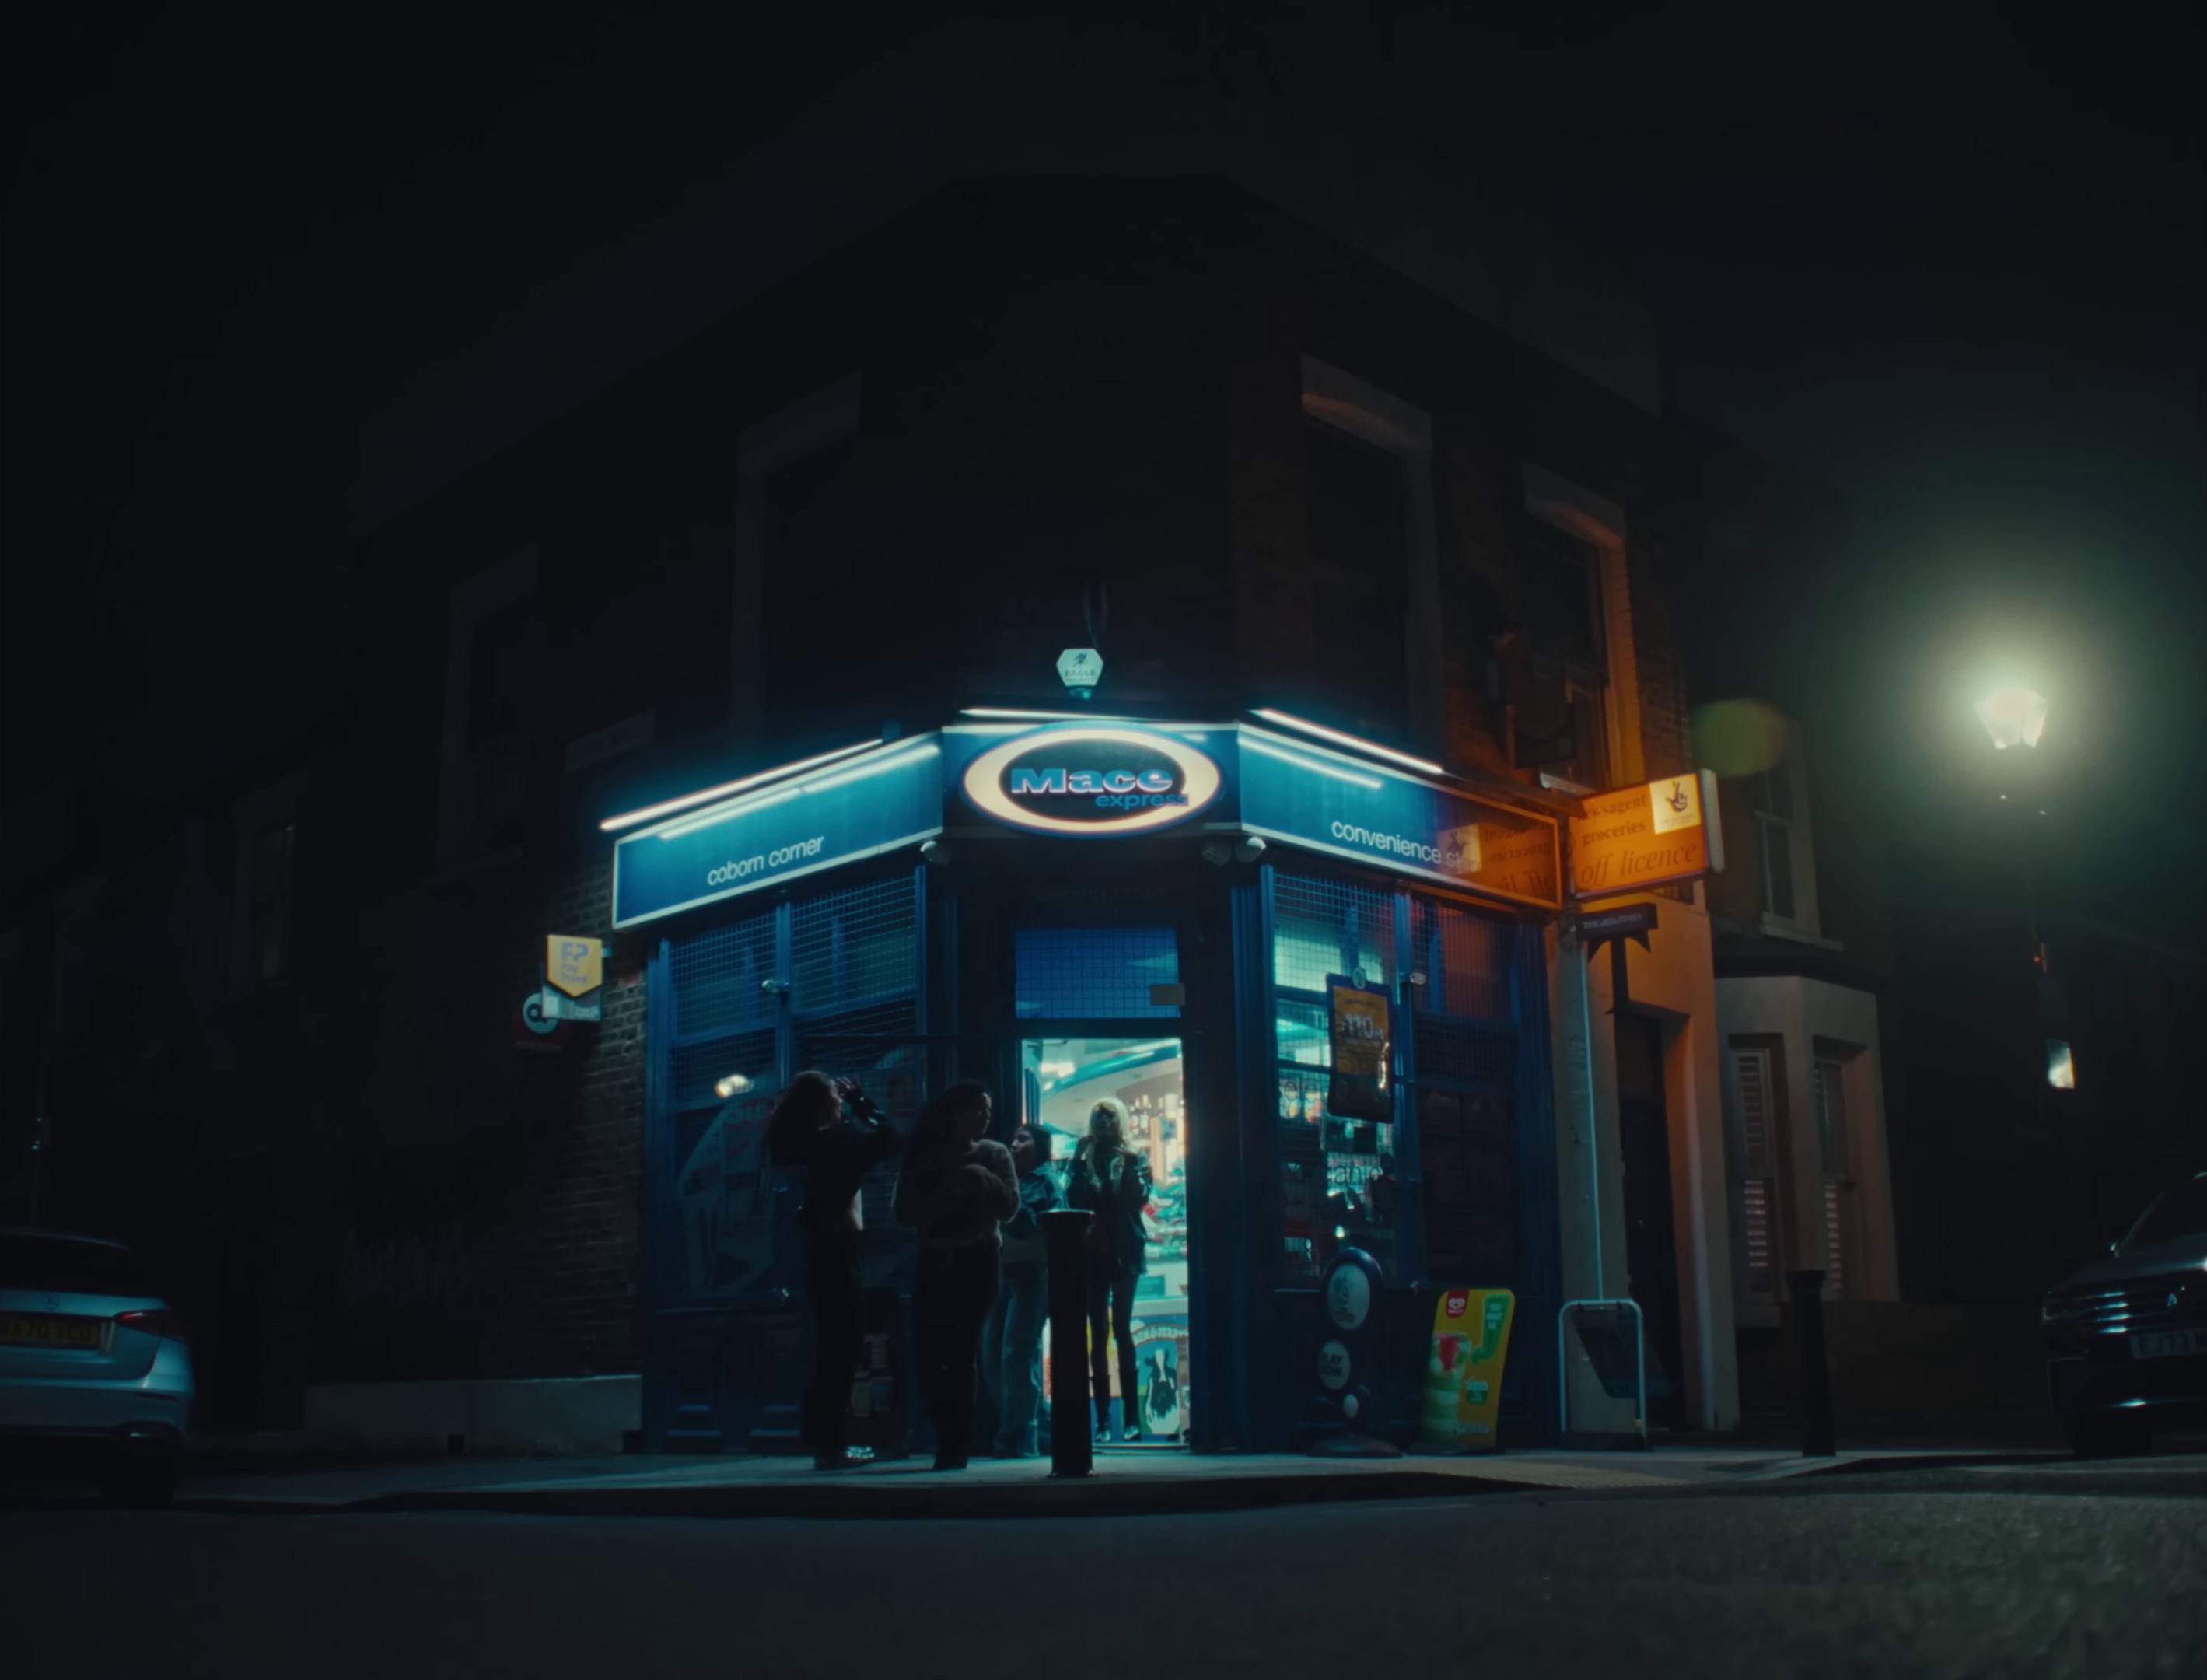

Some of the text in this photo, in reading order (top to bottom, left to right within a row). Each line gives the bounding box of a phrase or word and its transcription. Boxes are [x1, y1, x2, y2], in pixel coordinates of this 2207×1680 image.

[1011, 768, 1173, 794] Mace
[1095, 794, 1188, 810] express
[1331, 821, 1442, 864] convenience
[1582, 819, 1646, 846] groceries
[707, 835, 825, 886] coborn corner
[1581, 842, 1697, 887] off licence
